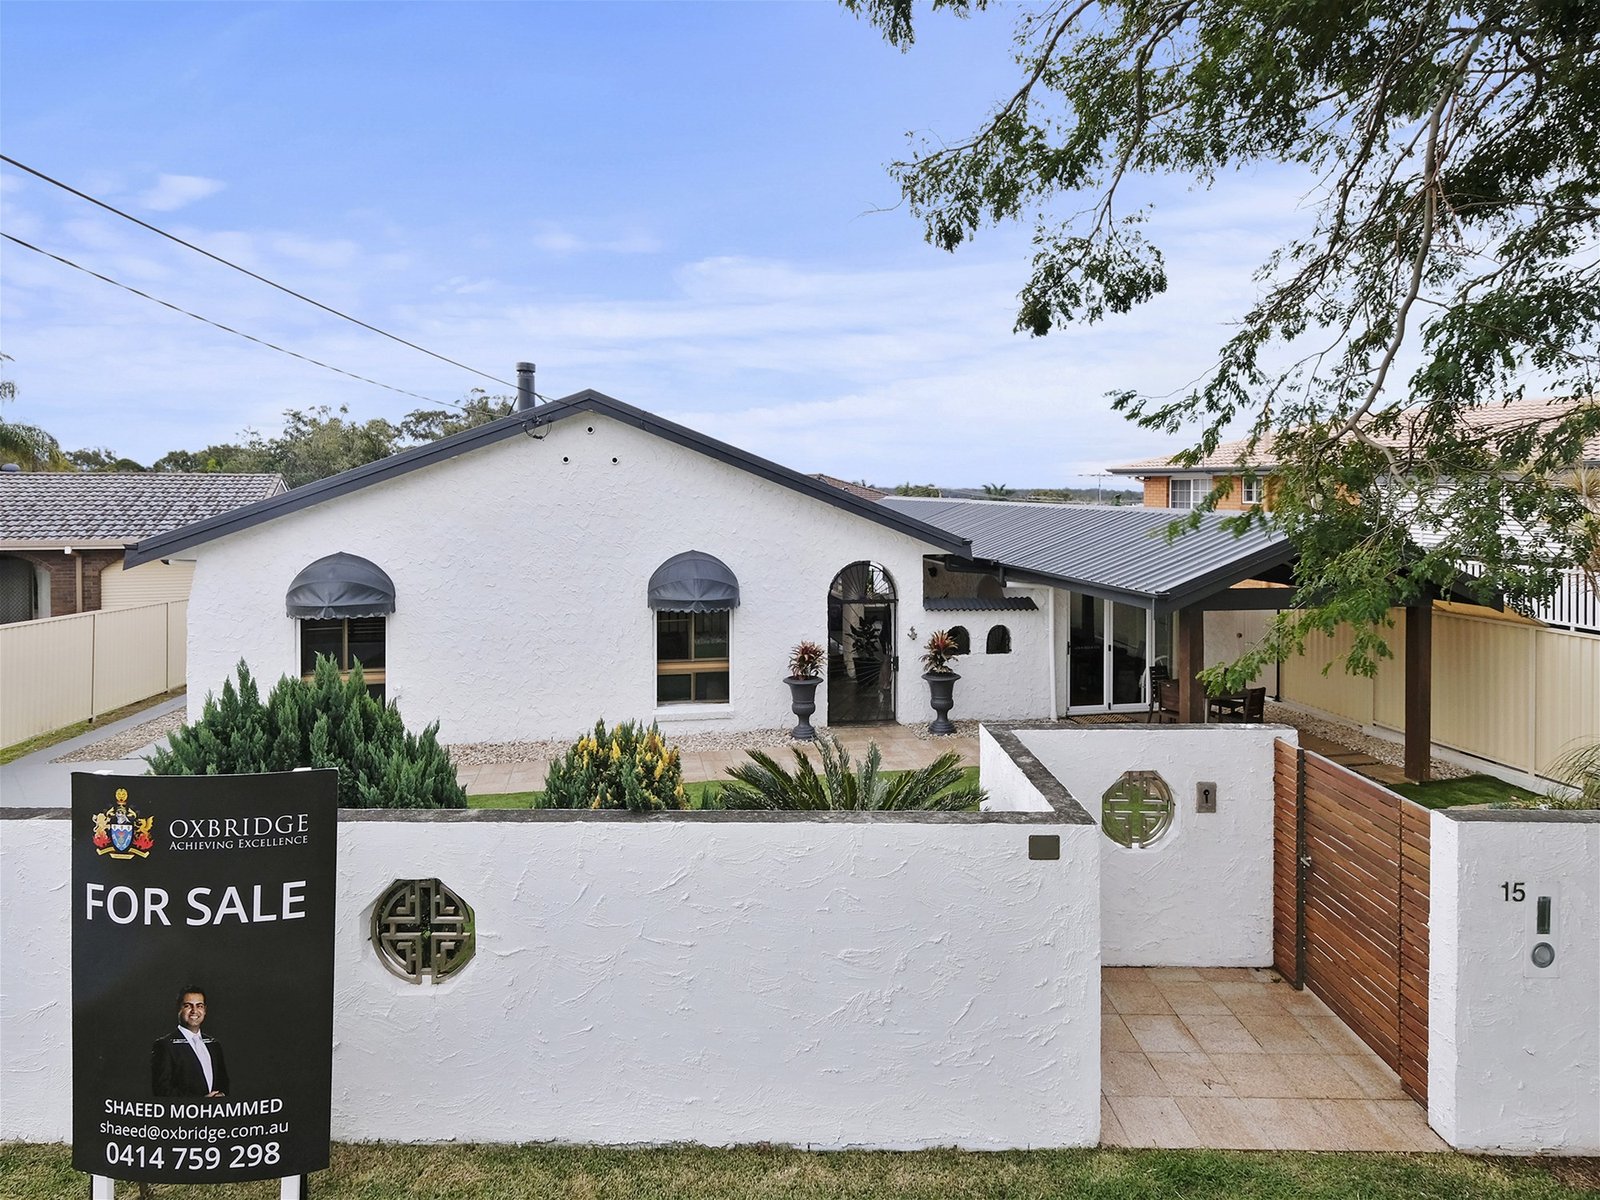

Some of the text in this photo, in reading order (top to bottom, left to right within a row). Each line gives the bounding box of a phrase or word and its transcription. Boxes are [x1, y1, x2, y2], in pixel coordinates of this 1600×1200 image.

[169, 813, 309, 839] OXBRIDGE
[169, 836, 309, 851] ACHIEVING EXCELLENCE
[86, 880, 307, 926] FOR SALE
[1501, 881, 1526, 902] 15
[104, 1097, 284, 1119] SHAEED MOHAMMED
[100, 1120, 289, 1143] shaeed@oxbridge.com.au
[106, 1141, 281, 1170] 0414 759 298
